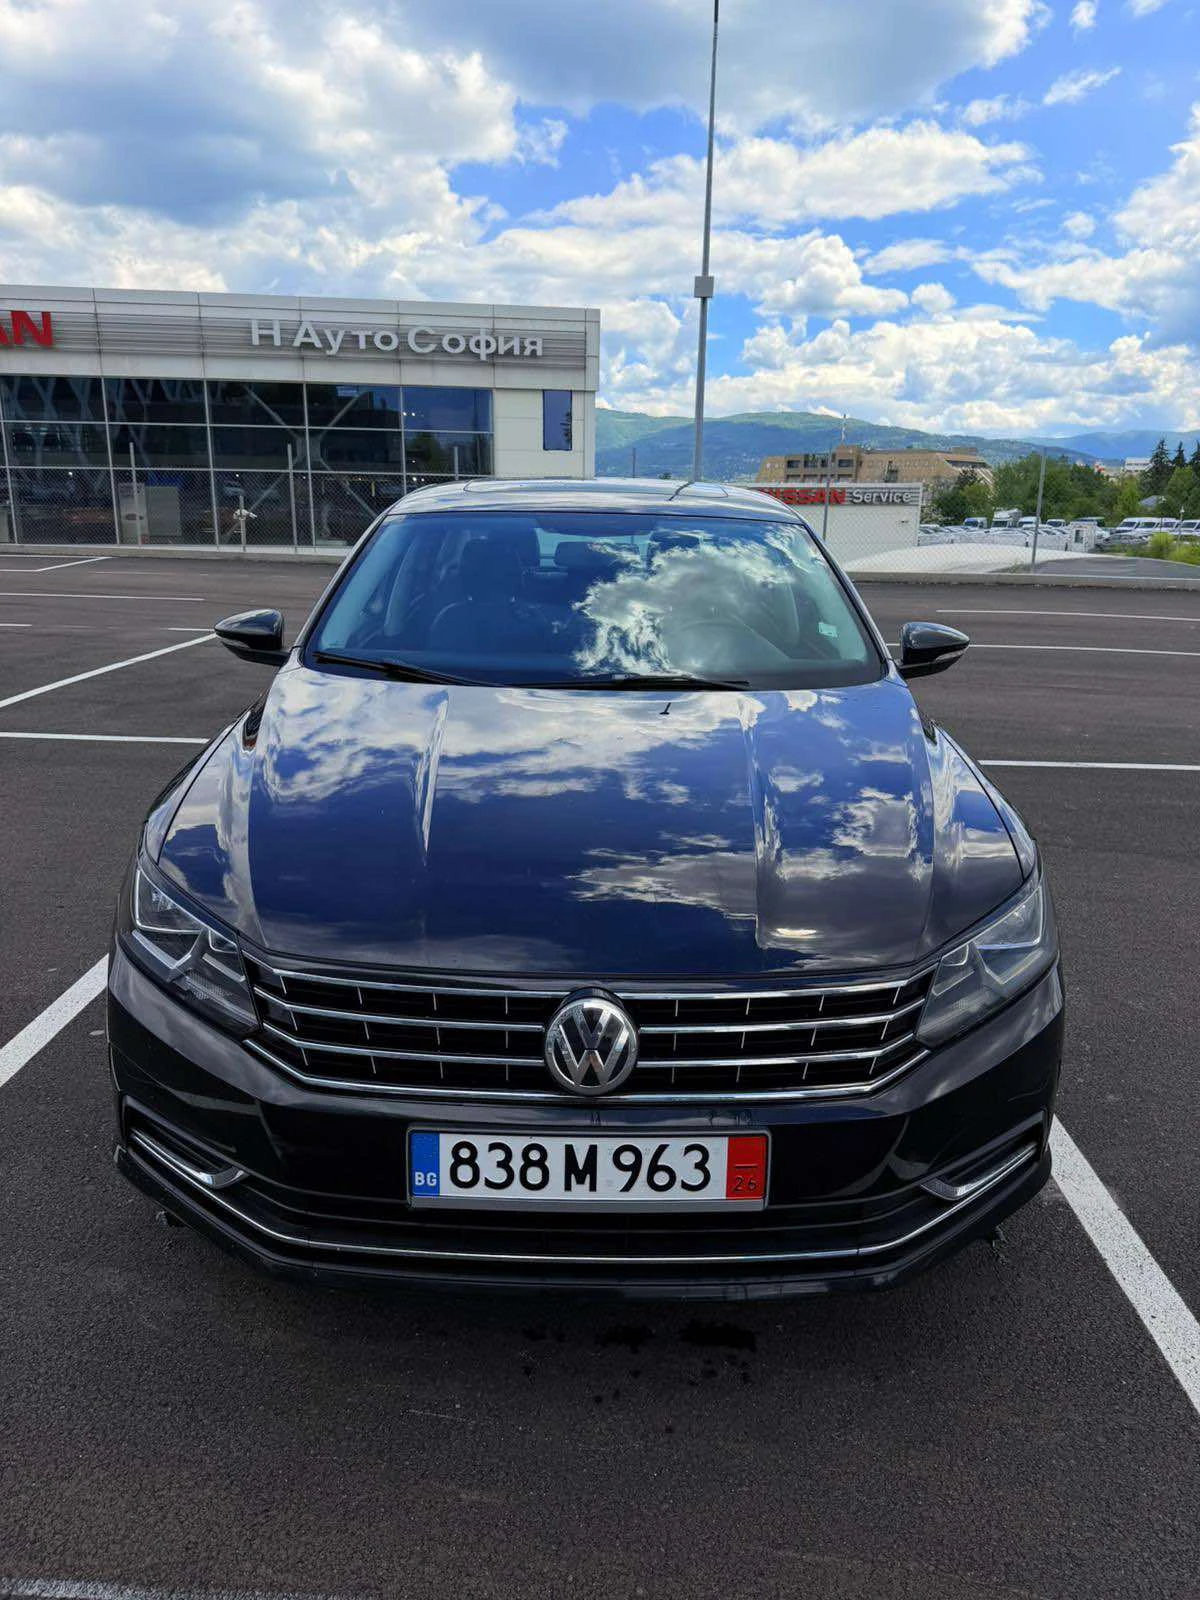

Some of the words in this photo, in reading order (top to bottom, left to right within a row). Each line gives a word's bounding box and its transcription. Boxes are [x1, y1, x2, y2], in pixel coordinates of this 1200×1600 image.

[0, 310, 53, 347] N
[292, 321, 399, 355] Ауто
[407, 325, 543, 361] София
[852, 488, 912, 504] Service
[414, 1171, 437, 1187] BG
[449, 1140, 550, 1191] 838
[564, 1144, 598, 1193] M
[612, 1143, 712, 1193] 963
[732, 1176, 757, 1192] 26
